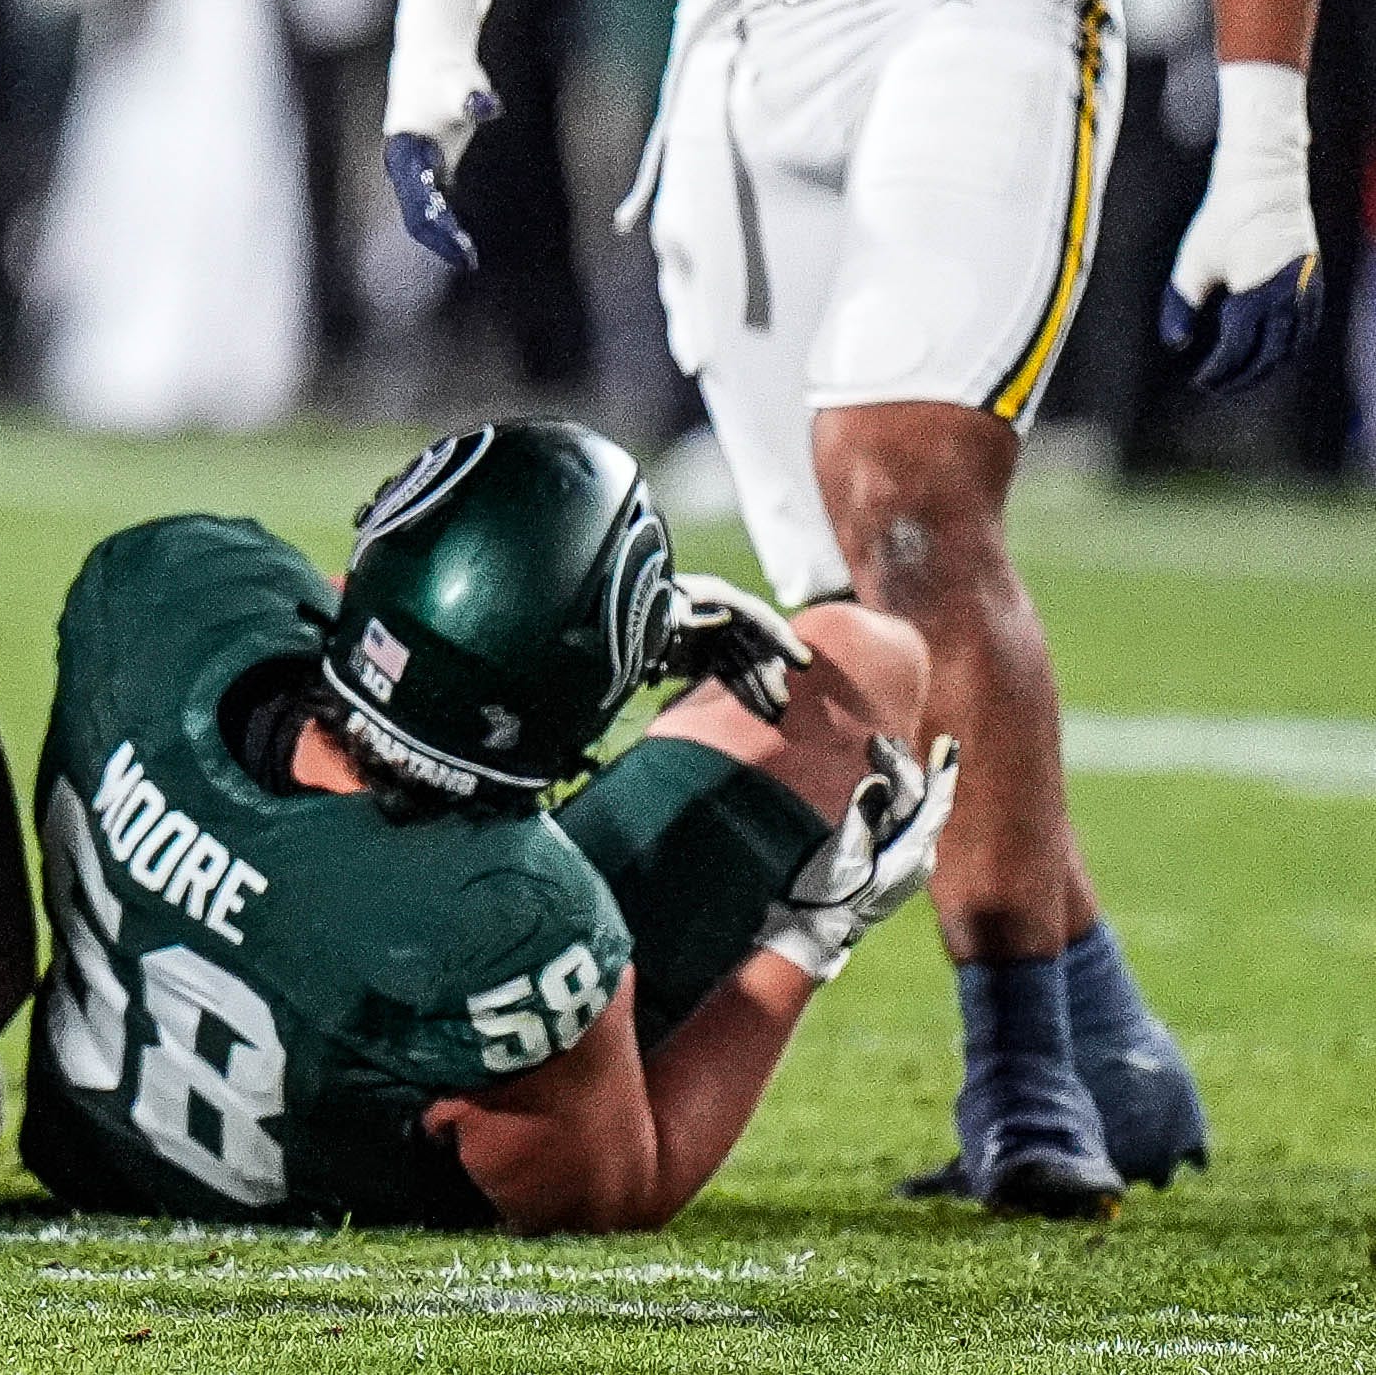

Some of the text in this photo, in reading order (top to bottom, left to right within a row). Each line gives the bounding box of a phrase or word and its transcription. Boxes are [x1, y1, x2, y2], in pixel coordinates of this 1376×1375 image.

[91, 739, 269, 946] MOORE
[50, 777, 288, 1206] 58
[467, 942, 610, 1073] 58
